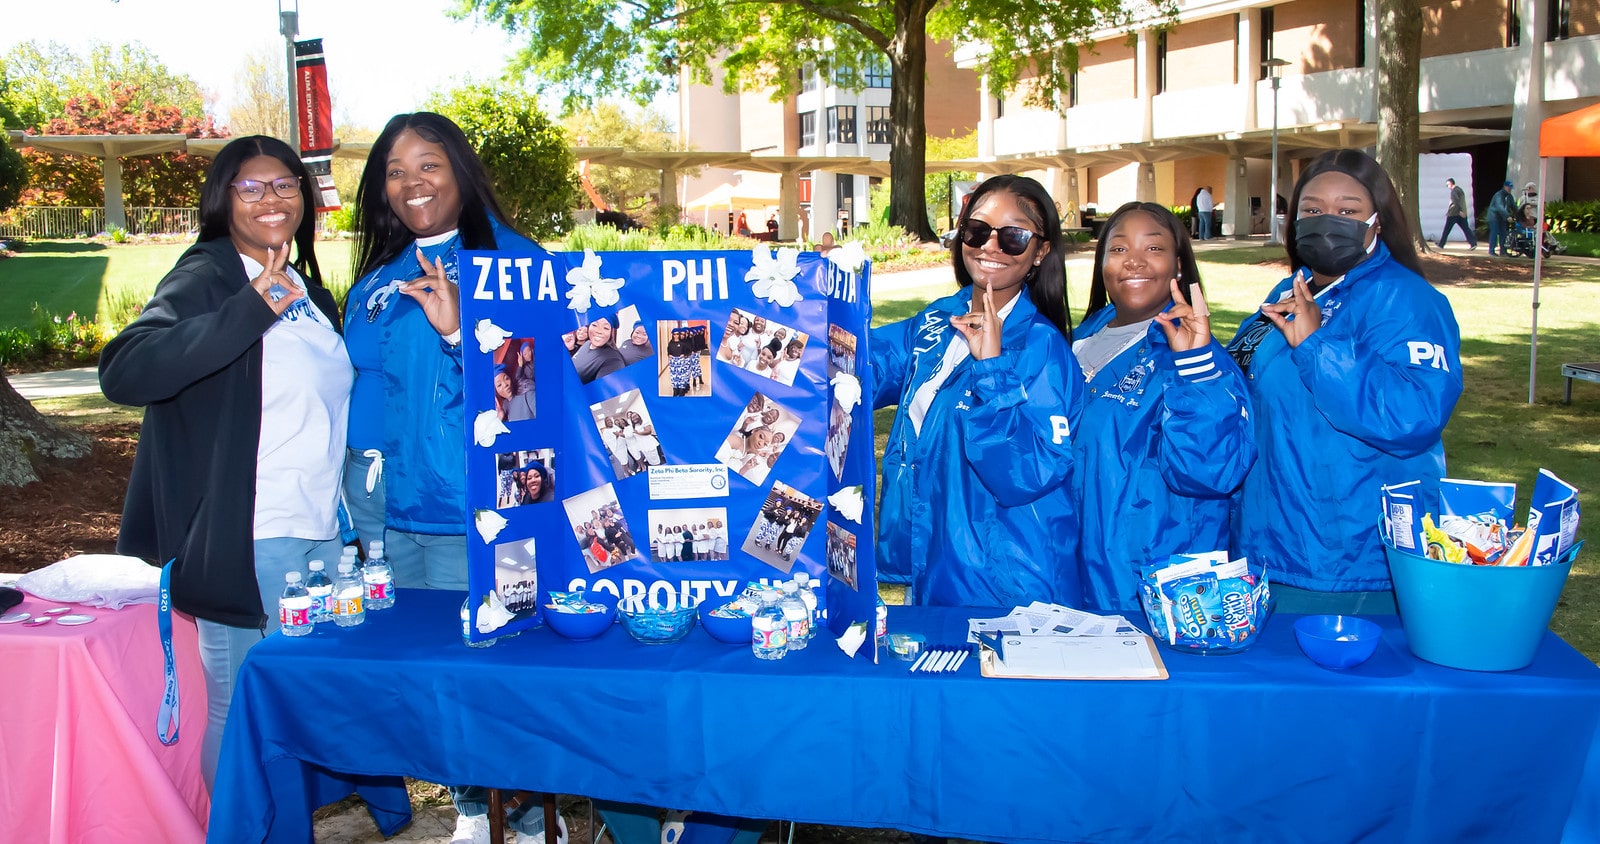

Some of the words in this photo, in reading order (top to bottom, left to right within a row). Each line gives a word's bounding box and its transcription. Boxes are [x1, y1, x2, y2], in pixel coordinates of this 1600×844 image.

[304, 70, 315, 148] AUM.EDU/EVENTS
[472, 256, 559, 302] ZETA
[662, 257, 729, 302] PHI
[1049, 415, 1070, 445] P
[160, 588, 168, 612] 1920
[1191, 597, 1206, 625] mini
[1225, 593, 1247, 621] Chips
[1180, 595, 1201, 638] OREO
